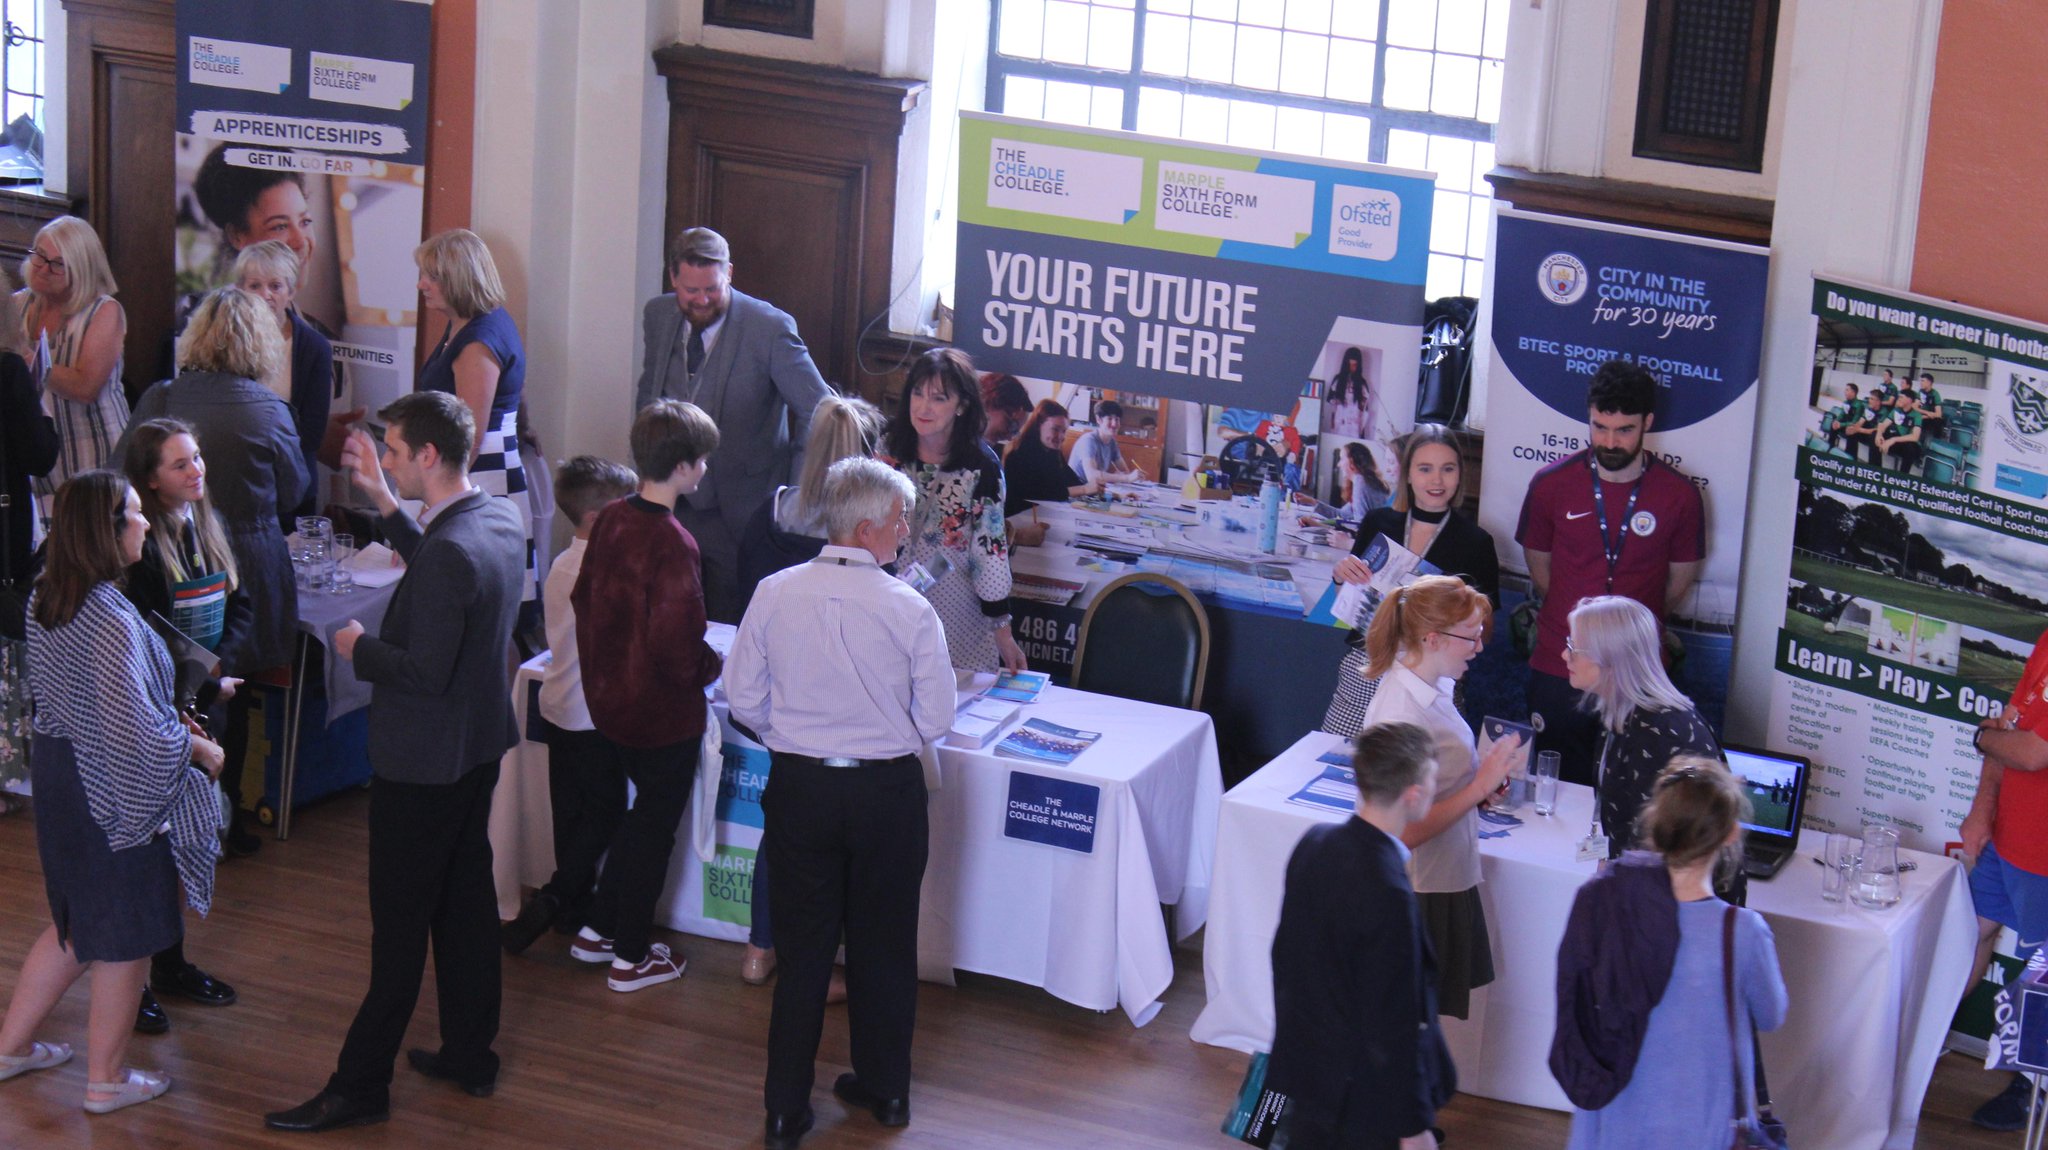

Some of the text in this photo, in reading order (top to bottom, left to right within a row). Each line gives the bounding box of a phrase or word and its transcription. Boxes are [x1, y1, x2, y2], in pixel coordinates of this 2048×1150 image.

[193, 51, 241, 65] CHEADLE
[194, 42, 213, 53] THE
[313, 67, 376, 83] SIXTH FORM
[214, 117, 382, 146] APPRENTICESHIPS
[248, 152, 273, 165] GET
[278, 155, 296, 168] IN.
[325, 159, 353, 172] FAR
[997, 148, 1026, 163] THE
[995, 161, 1065, 182] CHEADLE
[1164, 170, 1225, 189] MARPLE
[994, 175, 1070, 197] COLLEGE.
[1163, 183, 1258, 208] SIXTH FORM
[1340, 204, 1392, 227] Ofsted
[1338, 226, 1361, 237] Good
[1337, 237, 1373, 249] Provider
[985, 249, 1258, 333] YOUR FUTURE
[1599, 266, 1706, 296] CITY IN THE
[1597, 283, 1711, 314] COMMUNITY
[1592, 297, 1717, 339] for 30 years
[1827, 290, 1846, 312] Do
[1848, 298, 1876, 320] you
[1878, 305, 1916, 329] want
[1917, 315, 1928, 332] a
[1929, 318, 1982, 344] career
[1983, 328, 2000, 349] in
[983, 301, 1245, 383] STARTS HERE
[332, 345, 394, 365] RTUNITIES
[1518, 336, 1560, 355] BTEC
[1563, 343, 1618, 362] SPORT
[1637, 355, 1723, 382] FOOTBALL
[1541, 433, 1579, 450] 16-18
[1809, 455, 2048, 525] Qualify at BTEC Level 2 Extended Cert in Sport an
[1812, 469, 1833, 483] train
[1834, 478, 1863, 491] under
[1864, 483, 1878, 495] FA
[1880, 488, 1889, 497] &
[1890, 489, 1915, 505] UEFA
[1917, 498, 1962, 516] qualified
[1964, 508, 2002, 527] football
[1020, 616, 1058, 642] 486
[1787, 639, 1853, 680] Learn
[1878, 664, 1931, 704] Play
[1958, 686, 2003, 720] Coa
[1793, 680, 1814, 694] Study
[1817, 687, 1825, 696] in
[1790, 704, 1817, 716] centre
[1825, 702, 1857, 715] modern
[1873, 703, 1927, 724] Matches and
[1788, 724, 1824, 740] Cheadle
[1789, 714, 1832, 731] education
[1872, 715, 1935, 739] weekly training
[1787, 735, 1819, 750] College
[1869, 736, 1929, 759] UEFA Coaches
[1871, 726, 1931, 749] sessions led by
[1827, 765, 1846, 778] BTEC
[1867, 755, 1927, 778] Opportunity to
[1951, 767, 1972, 779] Gain
[1864, 776, 1896, 792] football
[1908, 790, 1927, 801] high
[1866, 767, 1936, 793] continue playing
[1045, 796, 1062, 807] THE
[1823, 787, 1841, 798] Cert
[1864, 787, 1884, 800] level
[1009, 800, 1094, 824] CHEADLE & MARPLE
[1009, 810, 1092, 834] COLLEGE NETWORK
[1862, 807, 1891, 822] Superb
[1893, 816, 1924, 833] training
[709, 882, 751, 904] COLL
